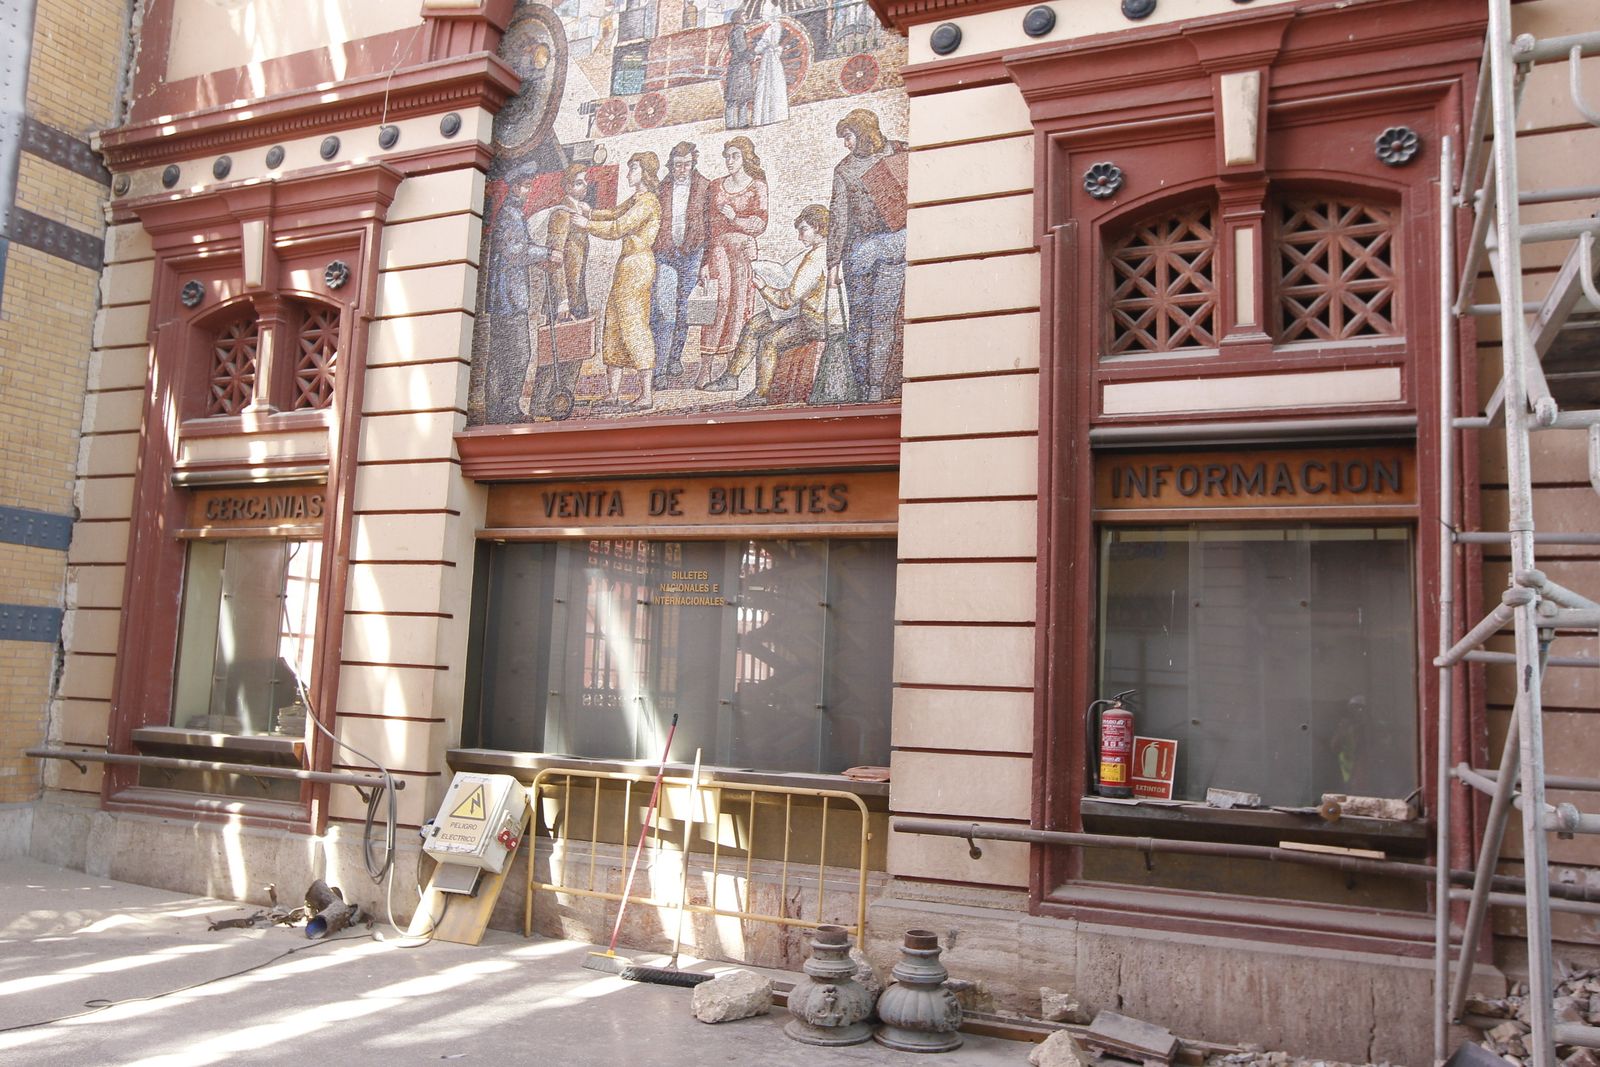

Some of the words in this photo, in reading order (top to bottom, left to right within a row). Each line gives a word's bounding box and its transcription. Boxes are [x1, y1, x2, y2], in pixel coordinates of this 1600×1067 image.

[1112, 459, 1402, 498] INFORMACION
[542, 489, 624, 517] VENTA
[648, 488, 685, 516] DE
[708, 484, 848, 515] BILLETES
[207, 494, 324, 520] CERCANIAS
[671, 571, 708, 580] BILLETES
[660, 583, 709, 593] NACIONALES
[713, 583, 719, 592] E
[652, 595, 725, 606] INTERNACIONALES
[1136, 784, 1166, 794] EXTINTOR
[449, 821, 478, 831] PELIGRO
[441, 833, 476, 843] ELECTRICO
